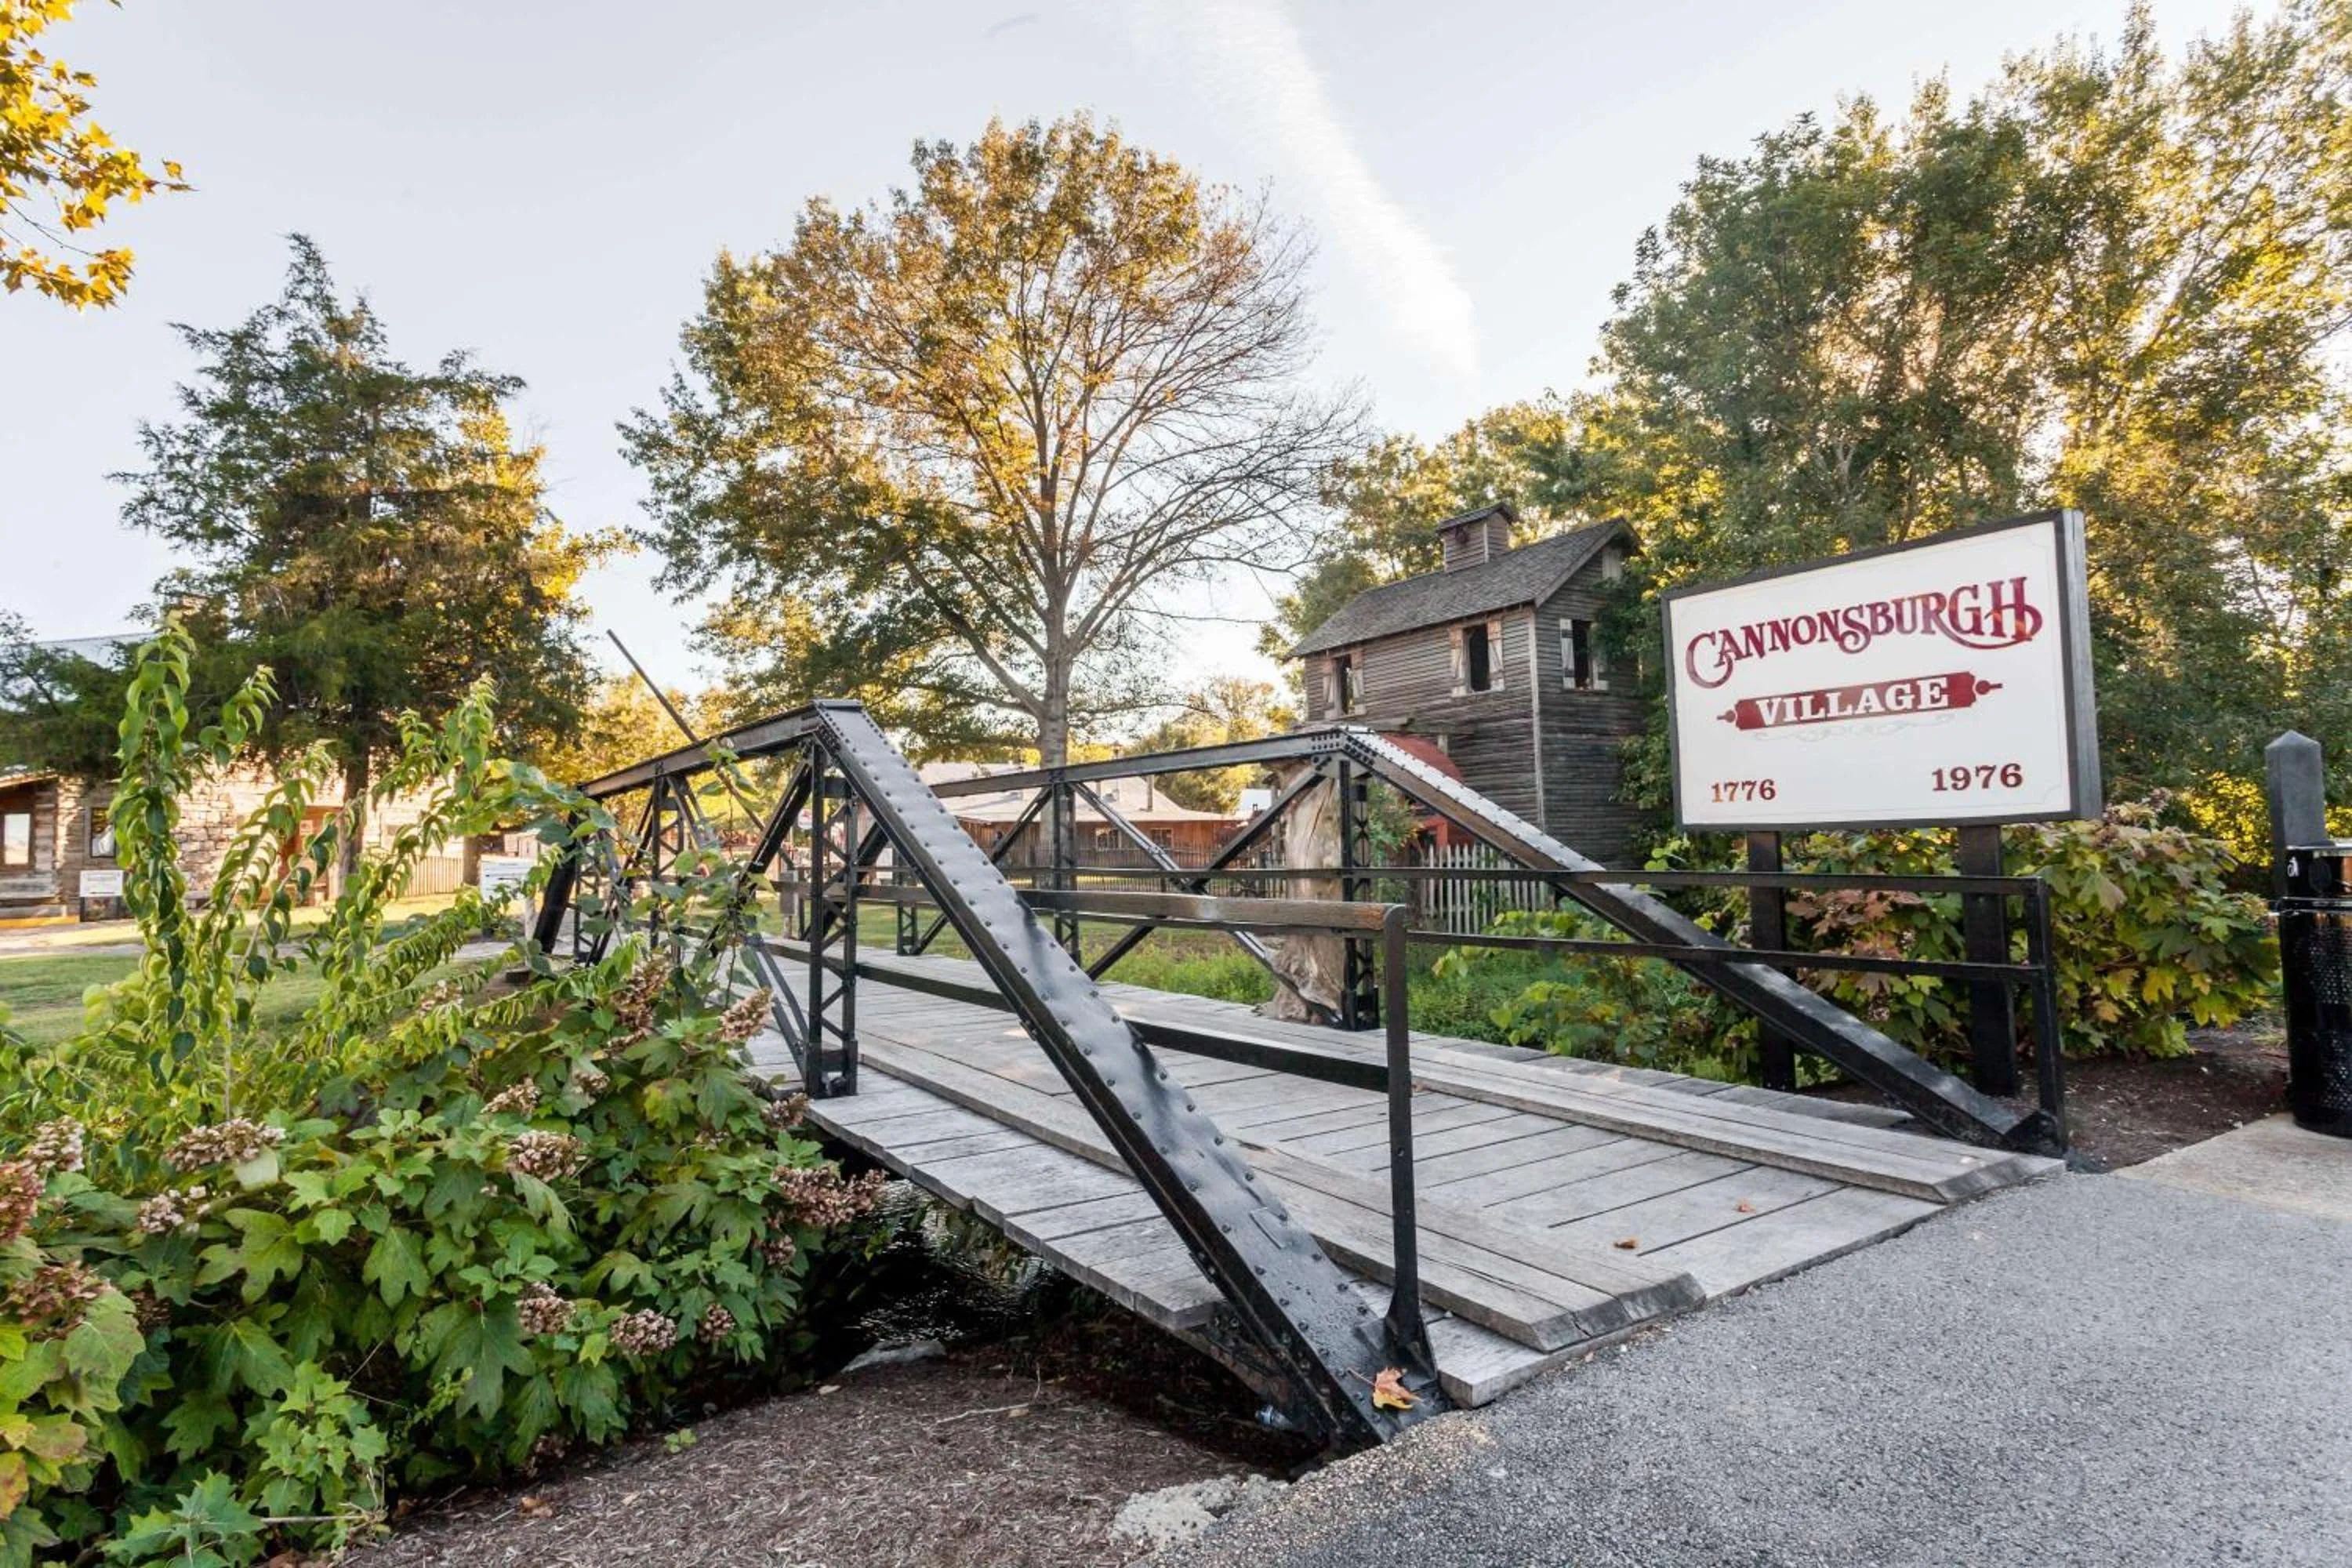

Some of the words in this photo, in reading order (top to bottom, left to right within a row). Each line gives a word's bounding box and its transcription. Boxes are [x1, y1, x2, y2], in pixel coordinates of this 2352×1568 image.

[1686, 576, 2042, 689] CANNONSBURGH
[1755, 677, 1949, 727] VILLAGE
[1711, 779, 1777, 804] 1776
[1932, 763, 2024, 791] 1976
